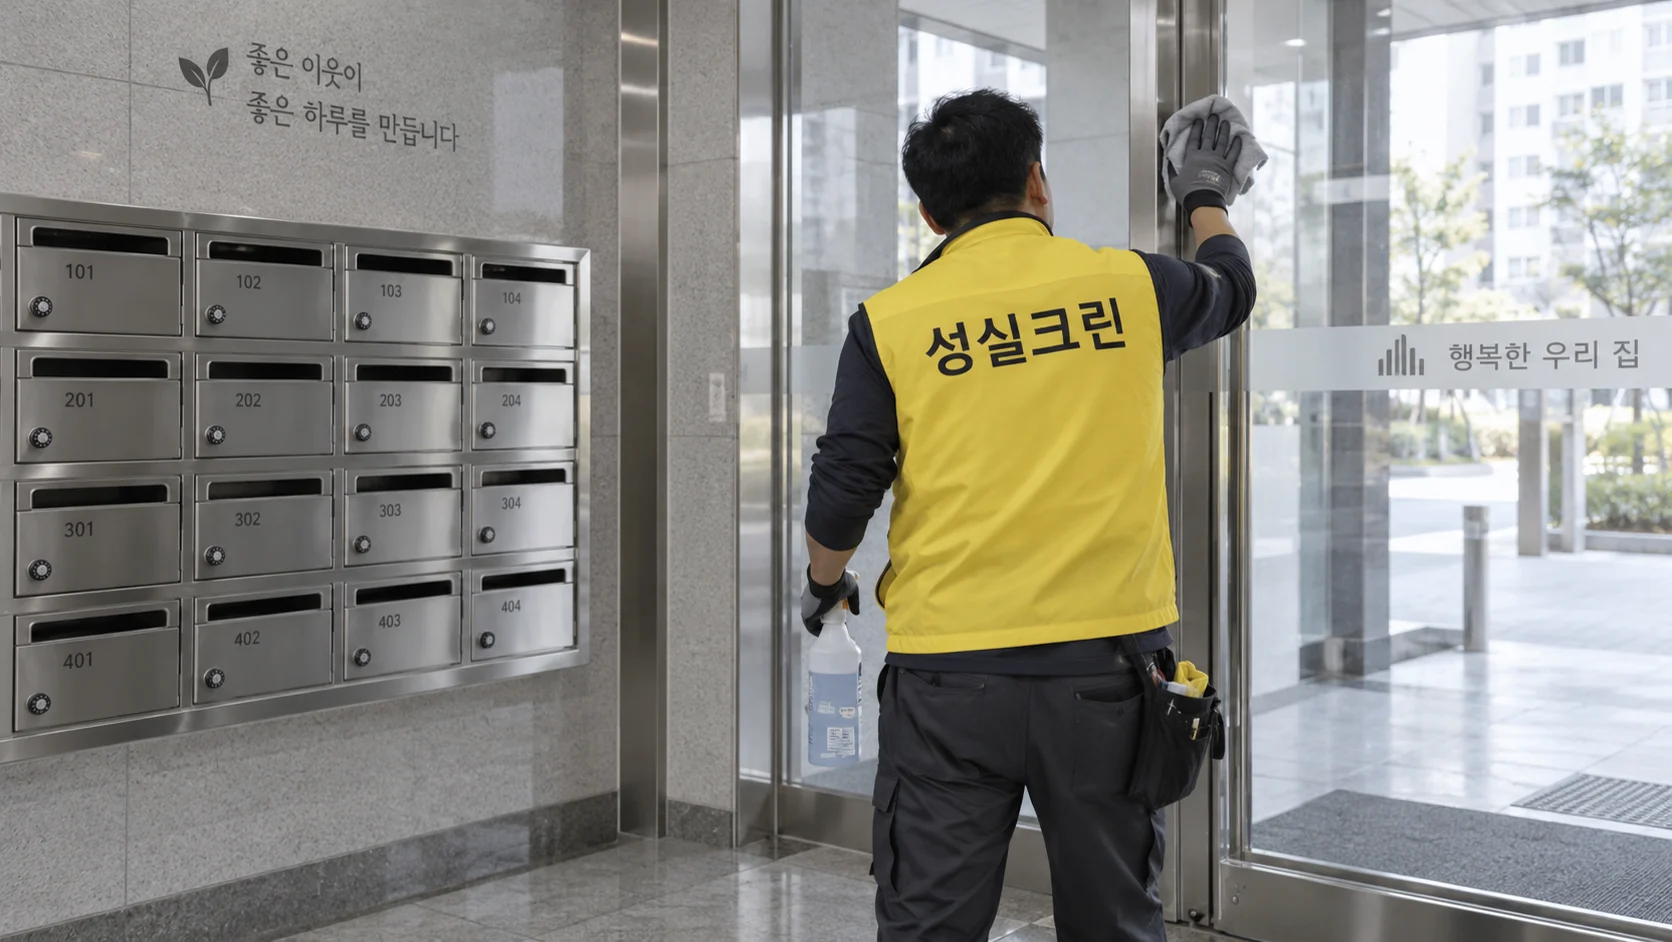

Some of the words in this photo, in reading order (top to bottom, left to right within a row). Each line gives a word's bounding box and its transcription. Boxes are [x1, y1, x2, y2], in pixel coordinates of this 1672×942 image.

[246, 42, 294, 80] 좋은
[302, 53, 362, 93] 이웃이
[246, 91, 294, 127] 좋은
[303, 100, 370, 140] 하루를
[379, 113, 460, 152] 만듭니다
[65, 263, 94, 280] 101
[236, 274, 261, 290] 102
[380, 284, 402, 298] 103
[502, 292, 521, 305] 104
[925, 297, 1126, 376] 성실크린
[1449, 342, 1531, 371] 행복한
[1542, 340, 1598, 370] 우리
[1612, 339, 1639, 369] 집
[64, 392, 94, 408] 201
[235, 393, 261, 407] 202
[380, 393, 402, 407] 203
[502, 394, 521, 407] 204
[379, 504, 402, 518] 303
[501, 497, 521, 510] 304
[235, 512, 261, 527] 302
[64, 521, 94, 538] 301
[501, 600, 521, 613] 404
[378, 614, 401, 629] 403
[234, 631, 260, 646] 402
[63, 651, 93, 669] 401
